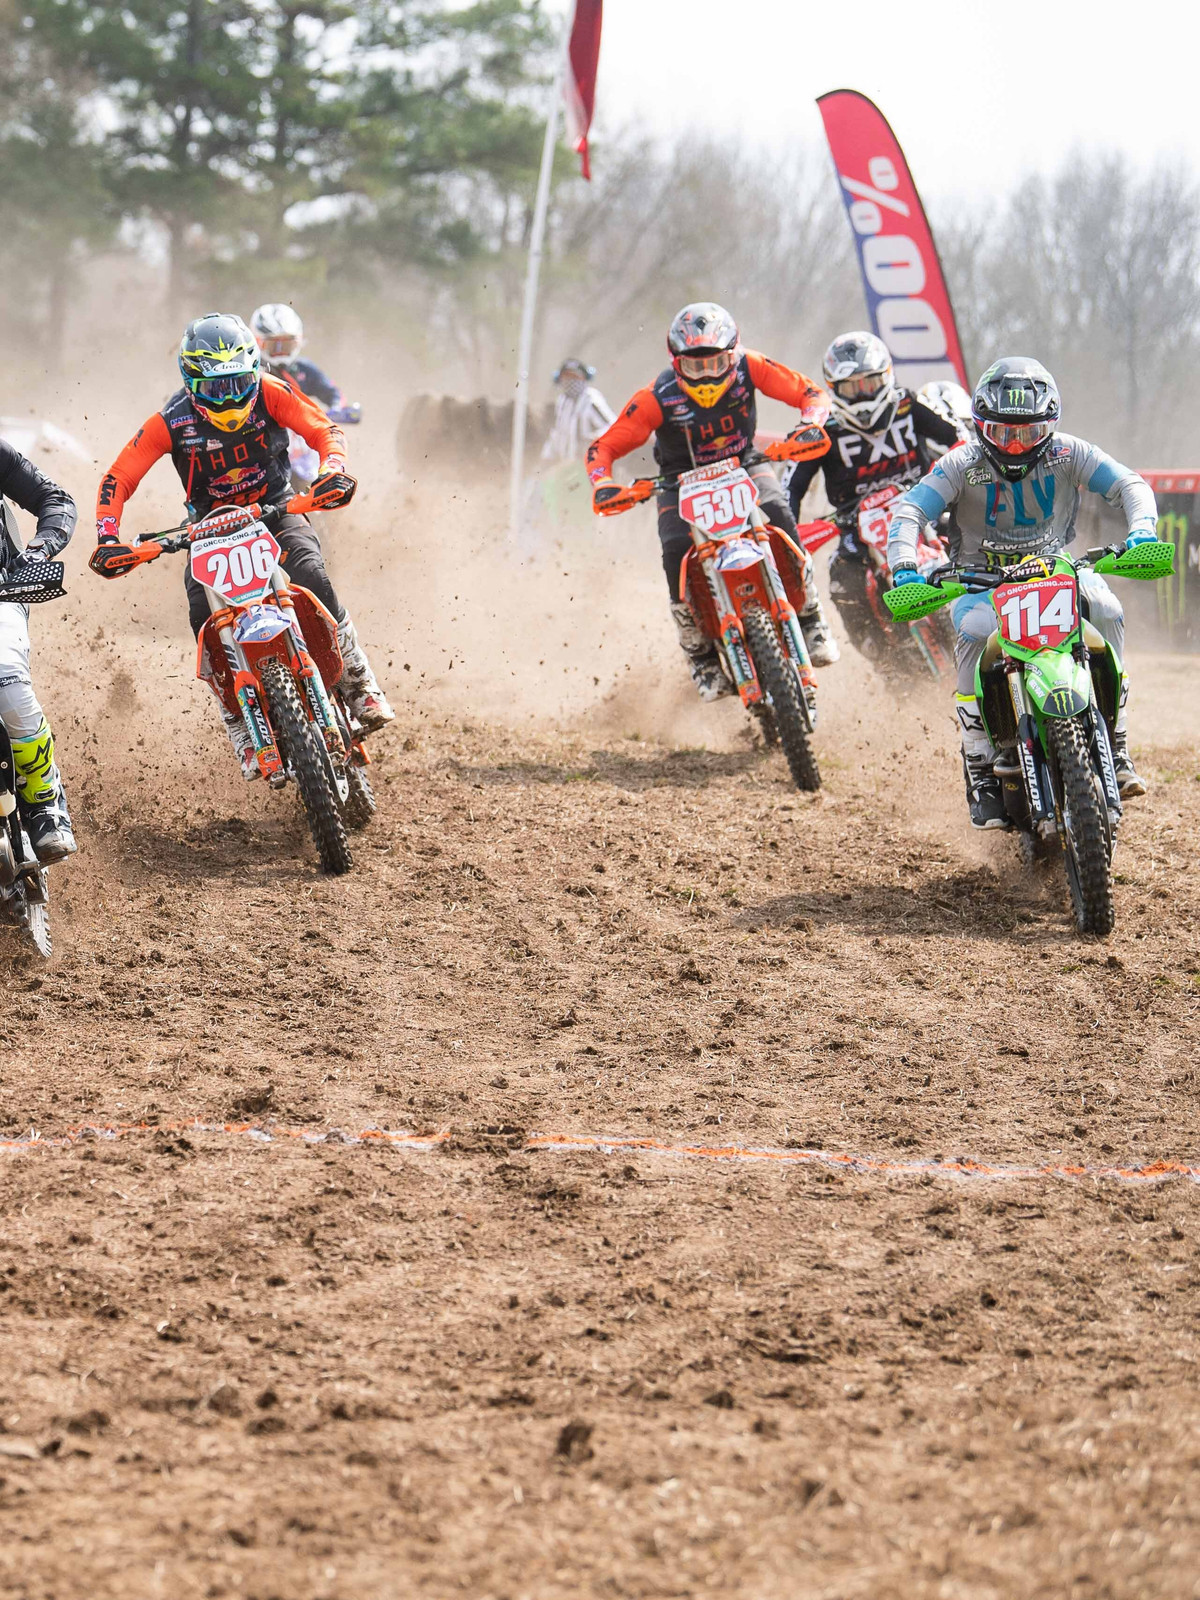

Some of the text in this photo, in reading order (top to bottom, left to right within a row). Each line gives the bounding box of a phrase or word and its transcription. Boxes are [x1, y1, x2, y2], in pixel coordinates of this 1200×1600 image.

[838, 413, 919, 469] FXR
[691, 482, 754, 531] 530
[985, 474, 1055, 528] FLY
[207, 538, 275, 594] 206
[1007, 580, 1073, 596] GNCCRACING.COM
[1001, 588, 1075, 642] 114
[246, 687, 273, 746] DNLOP
[1095, 729, 1117, 801] DUNLOP
